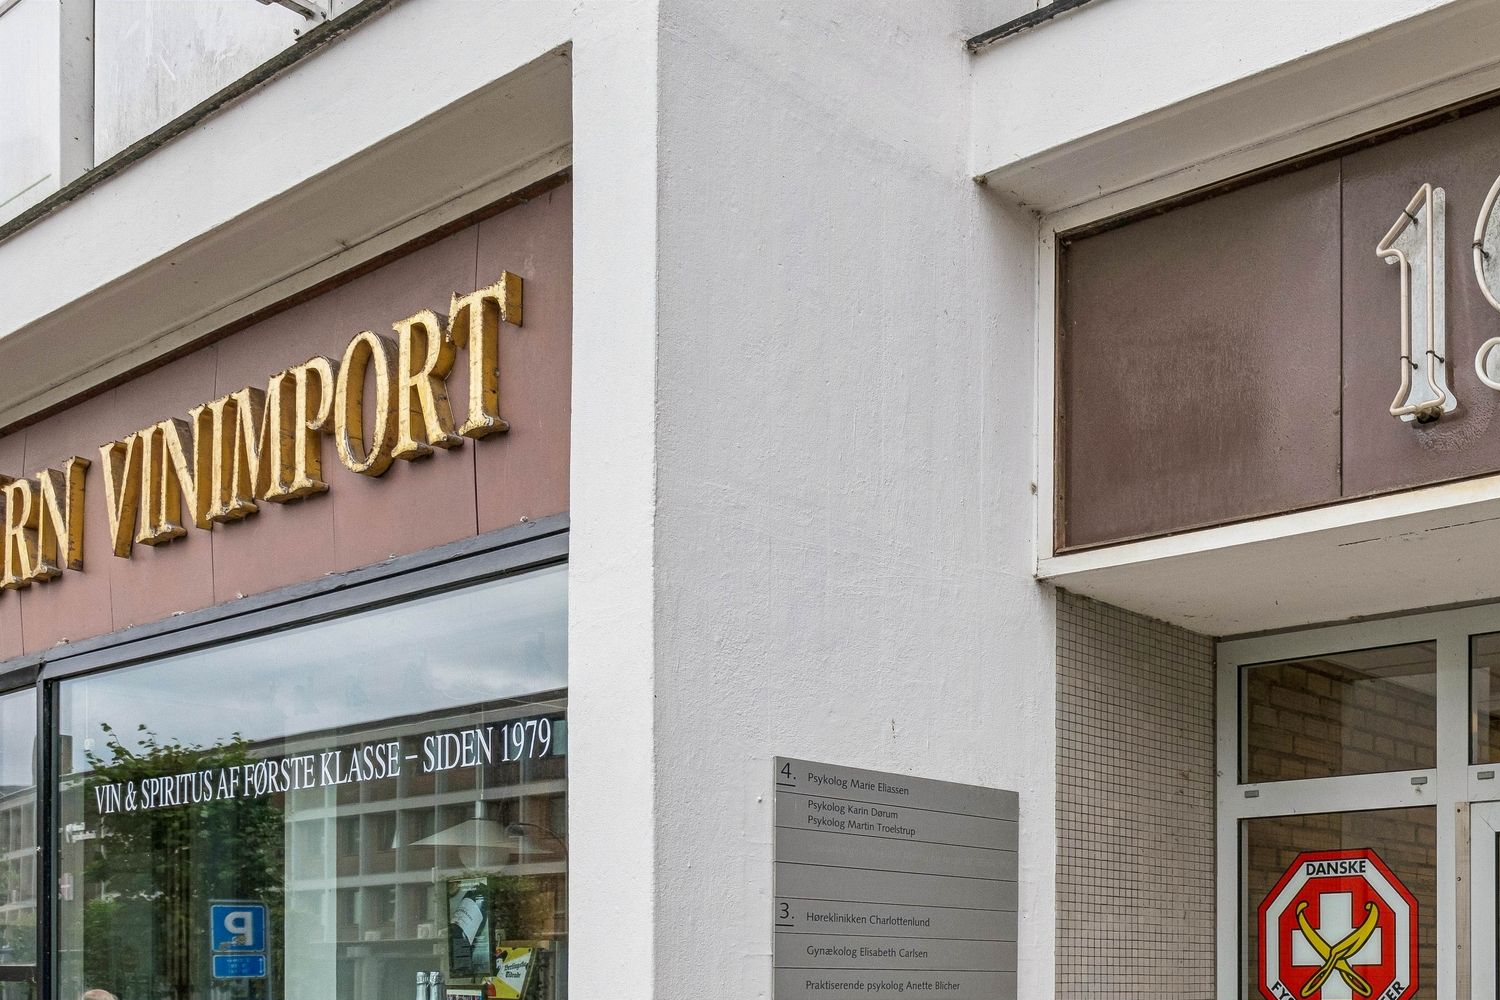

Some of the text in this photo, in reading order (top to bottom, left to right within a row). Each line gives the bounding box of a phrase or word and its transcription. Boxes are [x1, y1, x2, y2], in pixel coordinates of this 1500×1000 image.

[0, 270, 523, 591] RN VINIMPORT
[95, 718, 551, 814] VIN & SPIRITUS AF FØRSTE KLASSE SIDEN 1979
[781, 763, 909, 795] 4. Psykolog Marie Eliassen
[808, 800, 898, 819] Psykolog Karin Dørum
[808, 816, 915, 835] Psykolog Martin Troelstrup
[1306, 859, 1366, 876] DANSKE
[780, 903, 930, 926] 3. Høreklinikken Charlottenlund
[807, 946, 927, 958] Gynækolog Elisabeth Carlsen
[806, 981, 960, 991] Praktiserende psykolog Anette Blicher
